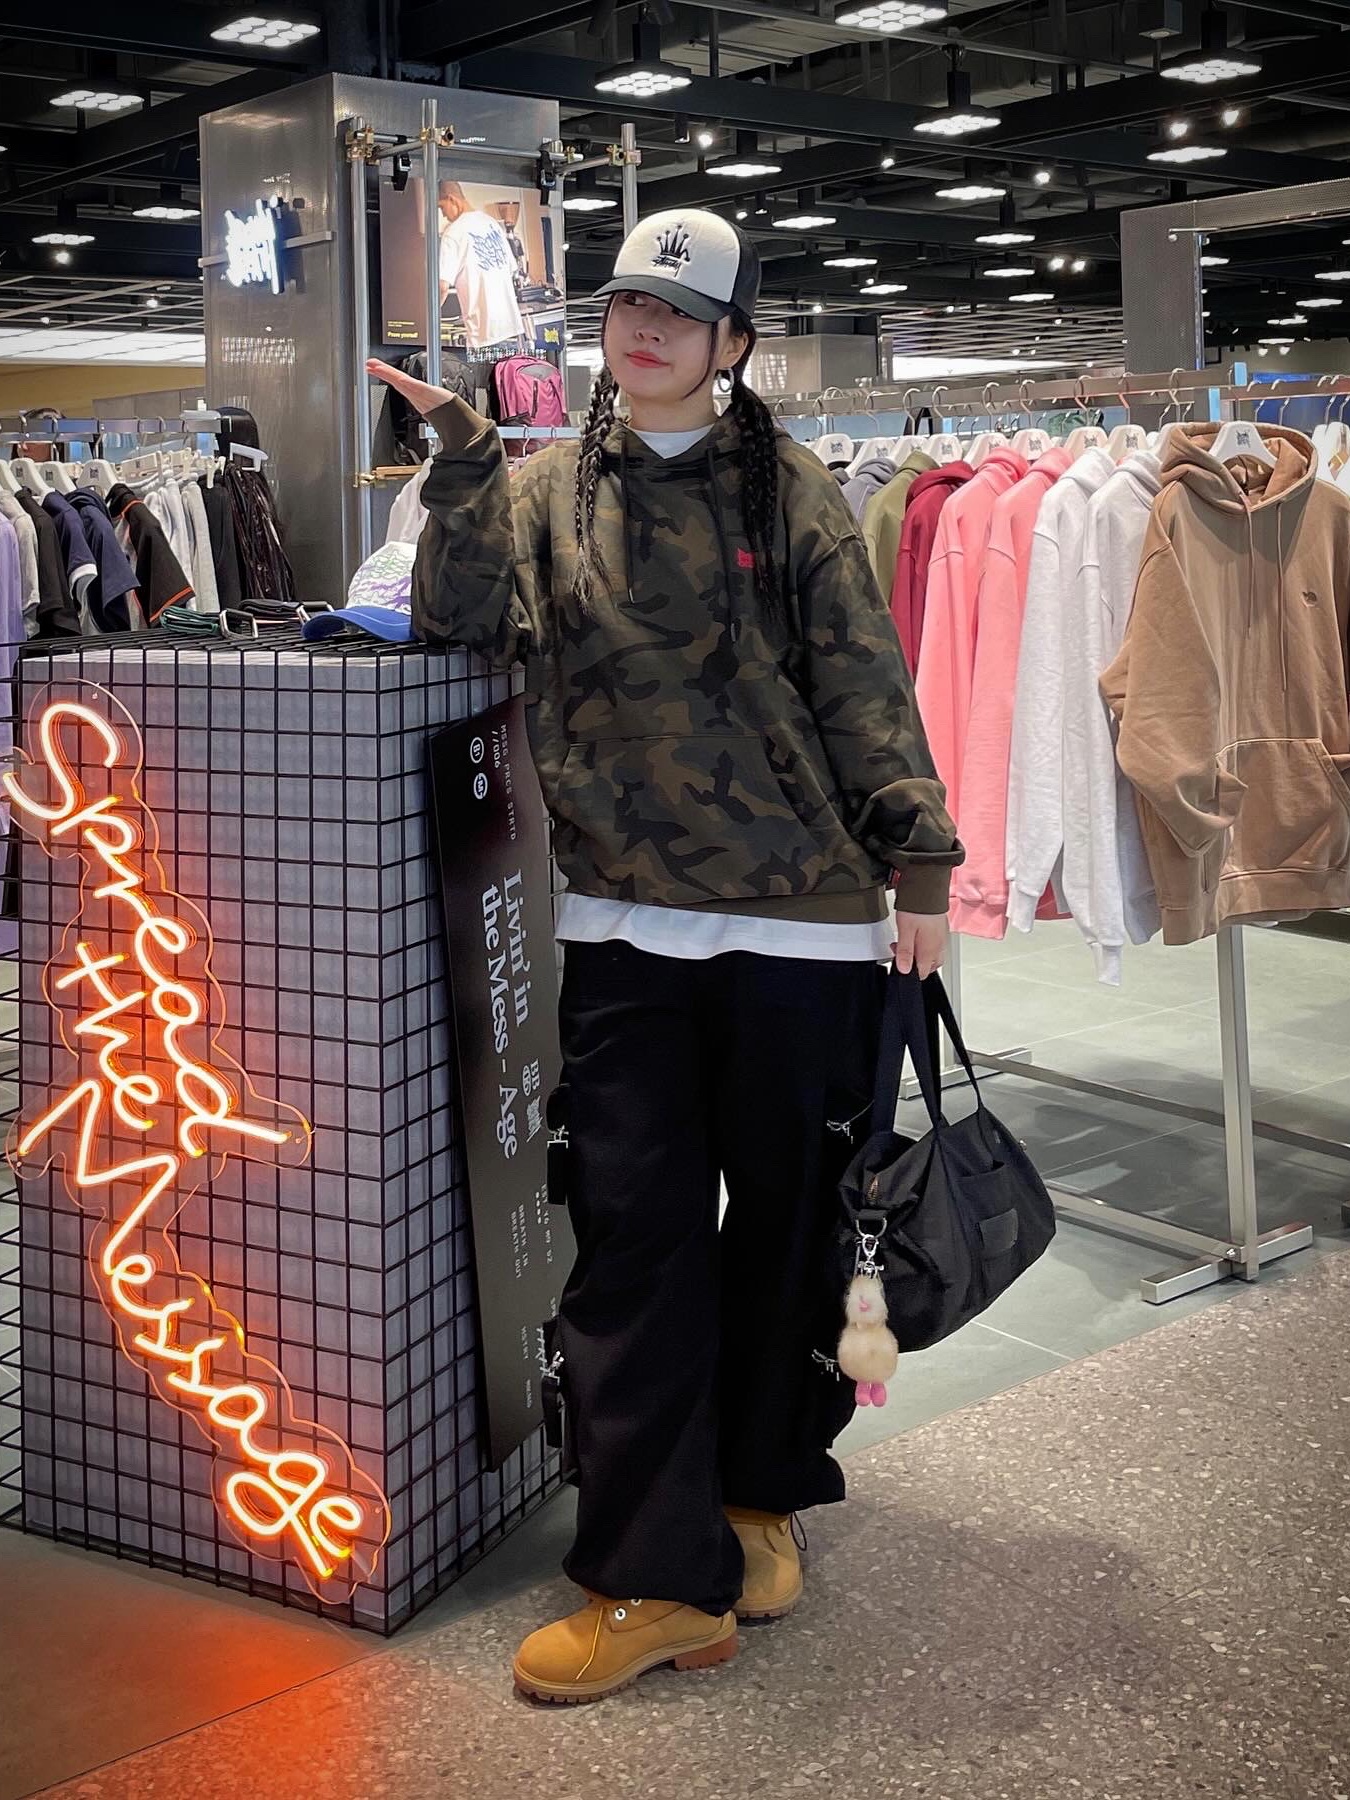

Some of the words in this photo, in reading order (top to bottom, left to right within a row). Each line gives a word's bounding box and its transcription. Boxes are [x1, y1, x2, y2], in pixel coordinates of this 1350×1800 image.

[3, 702, 292, 1157] Spread
[482, 884, 503, 950] the
[55, 942, 160, 1131] the
[488, 950, 509, 1054] Mess
[514, 980, 531, 1027] in
[530, 1058, 540, 1090] BB
[497, 1084, 518, 1159] Age
[17, 1078, 364, 1578] Message
